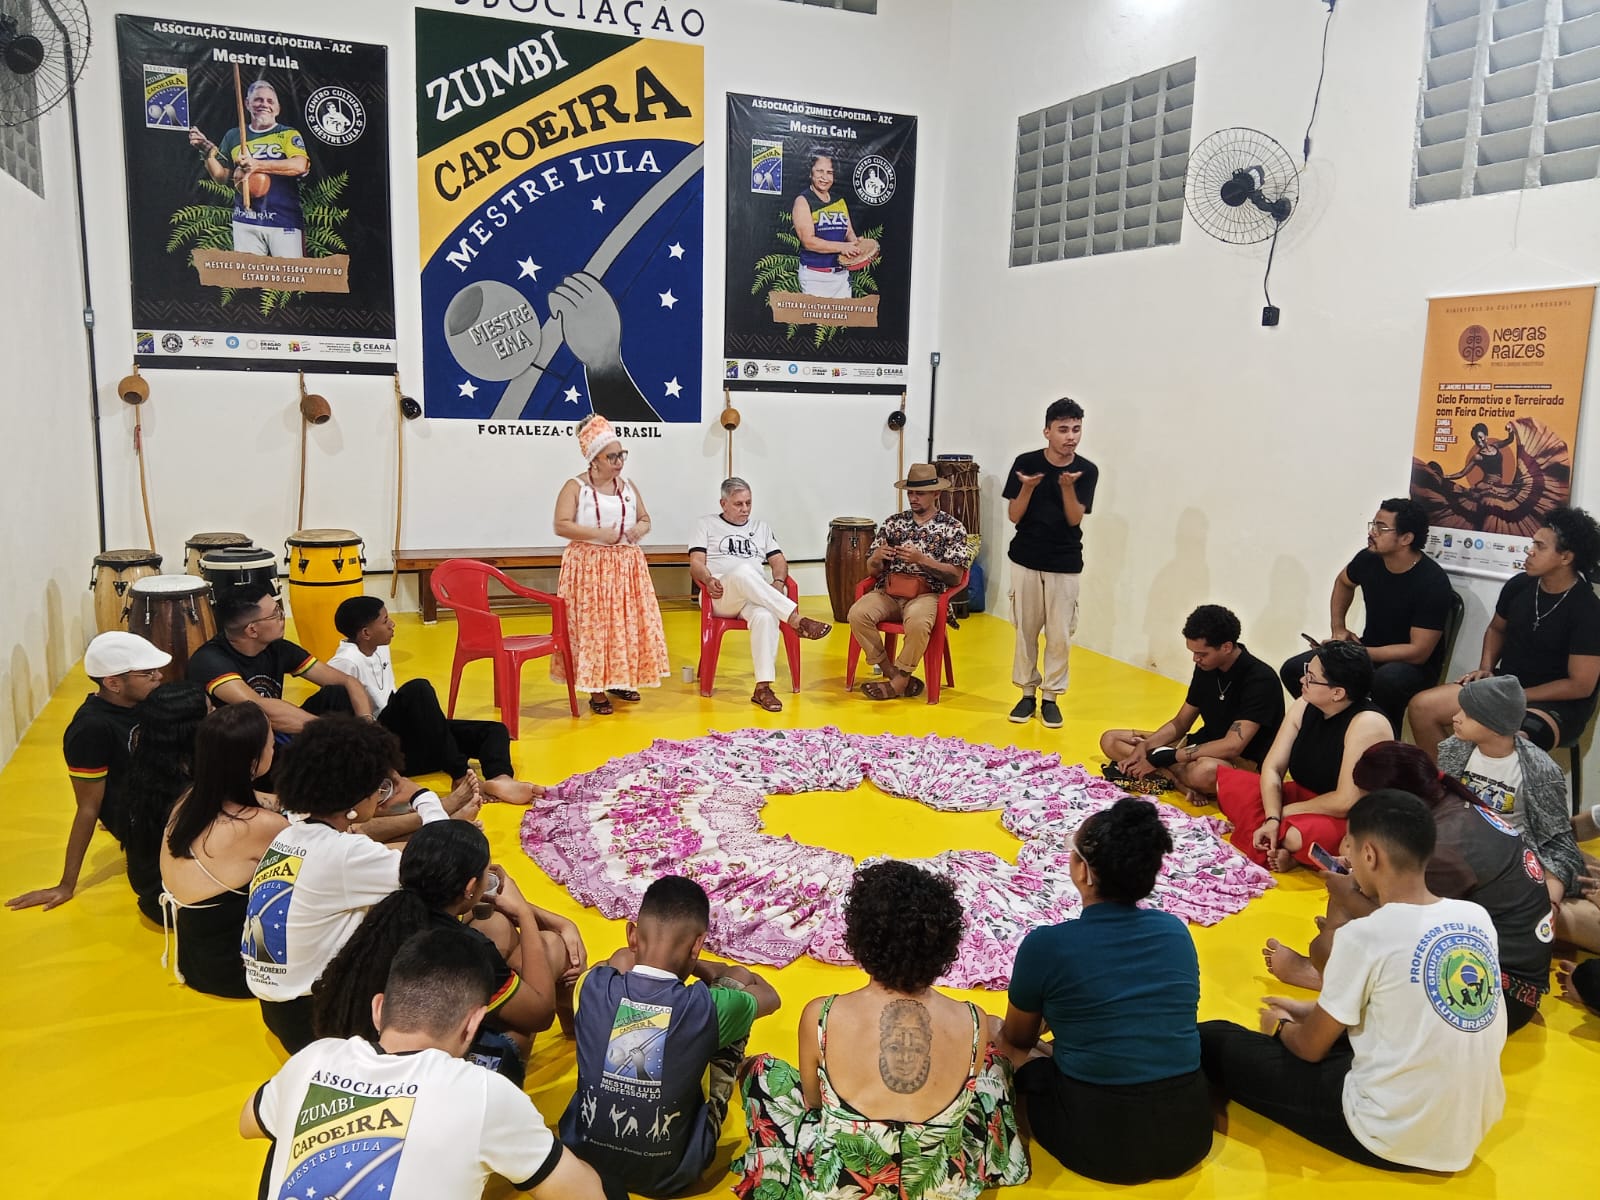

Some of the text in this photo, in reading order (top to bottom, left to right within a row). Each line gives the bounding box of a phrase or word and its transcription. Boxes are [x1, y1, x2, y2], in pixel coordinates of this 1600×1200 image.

[455, 0, 704, 37] CIAÇÃO
[153, 21, 227, 40] ASSOCIAÇÃO
[228, 30, 267, 44] ZUMBI
[268, 35, 322, 51] CAPOEIRA
[332, 42, 353, 54] AZC
[213, 48, 299, 70] Mestre Lula
[147, 77, 185, 95] CAPOEIRA
[425, 29, 569, 122] ZUMBI
[308, 89, 363, 118] CENTRO CULTURAL
[751, 99, 804, 114] ASSOCIAÇÃO
[805, 105, 832, 117] ZUMBI
[833, 109, 872, 122] CAPOEIRA
[878, 115, 893, 125] AZC
[312, 124, 361, 144] MESTRE LULA
[434, 65, 693, 202] CAPOEIRA
[790, 120, 857, 139] Mestra Carla
[445, 150, 662, 272] MESTRE LULA
[205, 262, 343, 276] MESTRE DA CULTURA TESOURO VIVO DO
[242, 273, 305, 283] ESTADO DO CEARÁ
[468, 303, 534, 346] MESTRE
[491, 329, 534, 360] EMA
[1436, 406, 1515, 417] com Feira Criativa
[1437, 394, 1564, 406] Ciclo Formativo e Terreirada
[616, 426, 662, 438] BRASIL
[1409, 926, 1444, 984] PROFESSOR
[1443, 923, 1465, 932] FEU
[1428, 948, 1442, 986] GRUPO
[1440, 938, 1454, 949] DE
[1435, 999, 1461, 1026] LUTA
[312, 1069, 419, 1097] ASSOCIAÇÃO
[600, 1082, 649, 1099] PROFESSOR
[601, 1077, 636, 1090] MESTRE
[638, 1086, 661, 1094] LULA
[300, 1096, 357, 1126] ZUMBI
[292, 1108, 403, 1160] CAPOEIRA
[286, 1141, 381, 1190] MESTRE LULA
